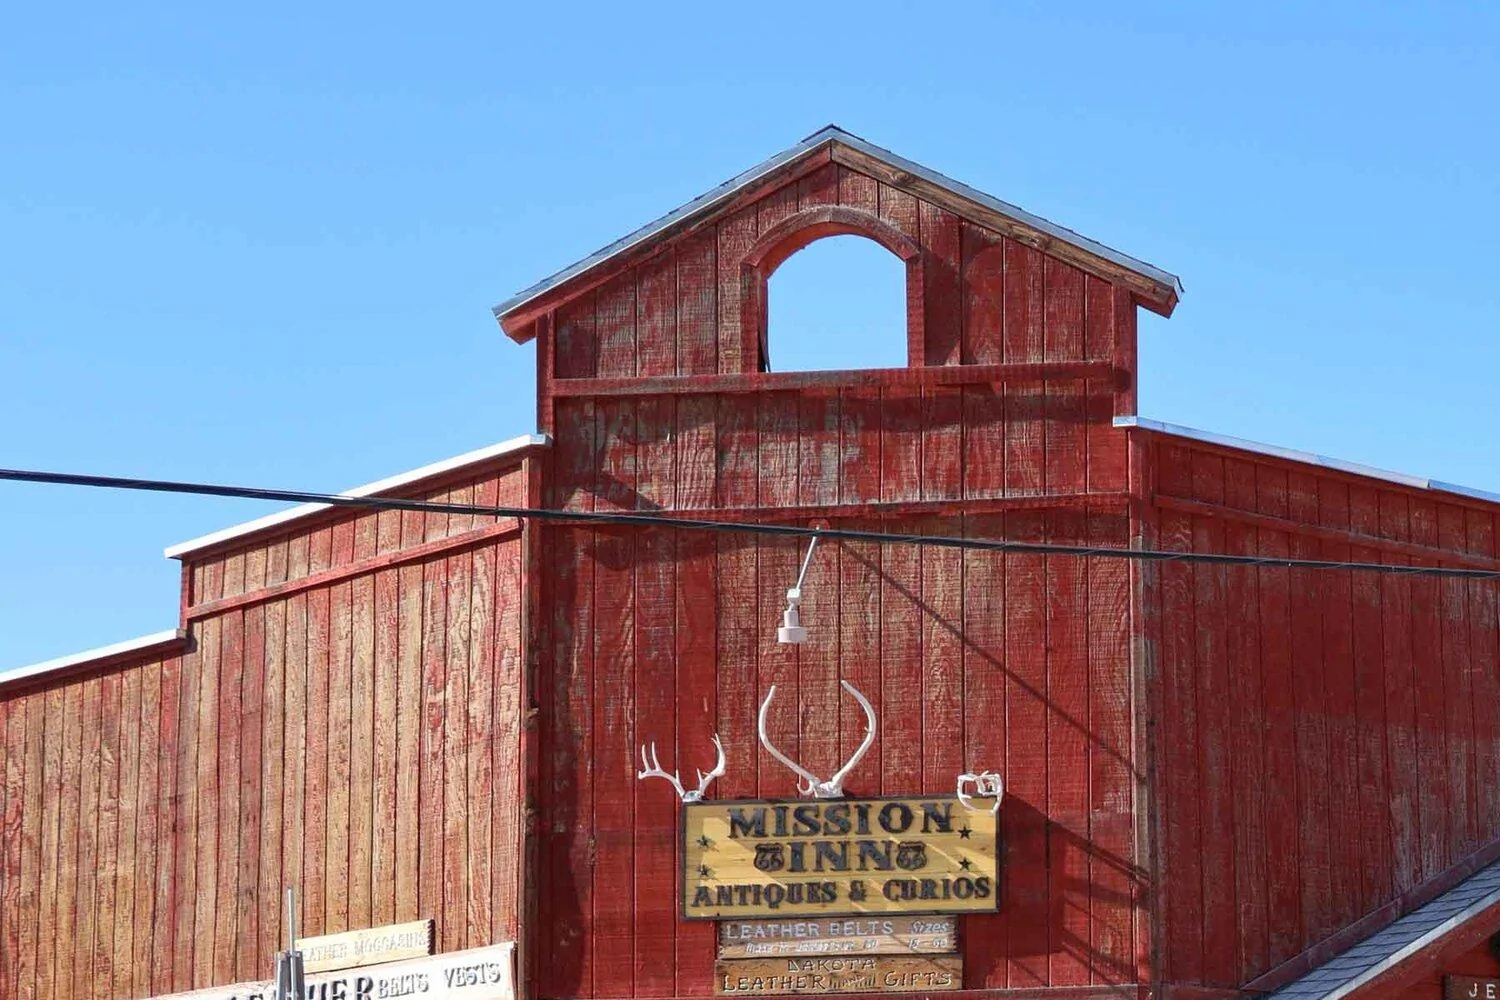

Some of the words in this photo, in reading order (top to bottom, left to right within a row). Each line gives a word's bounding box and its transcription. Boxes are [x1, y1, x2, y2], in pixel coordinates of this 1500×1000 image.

[728, 802, 955, 839] MISSION
[787, 840, 897, 873] INN
[691, 881, 837, 909] ANTIQUES
[849, 880, 866, 901] &
[882, 876, 991, 901] CURIOS
[726, 923, 820, 939] LEATHER
[829, 920, 894, 936] BELTS
[910, 921, 949, 934] Sizes
[302, 942, 347, 962] EATHER
[787, 957, 878, 973] DAKOTA
[378, 972, 430, 999] BELTS
[444, 962, 501, 988] VESTS
[722, 973, 826, 992] LEATHER
[883, 970, 952, 988] GIFTS
